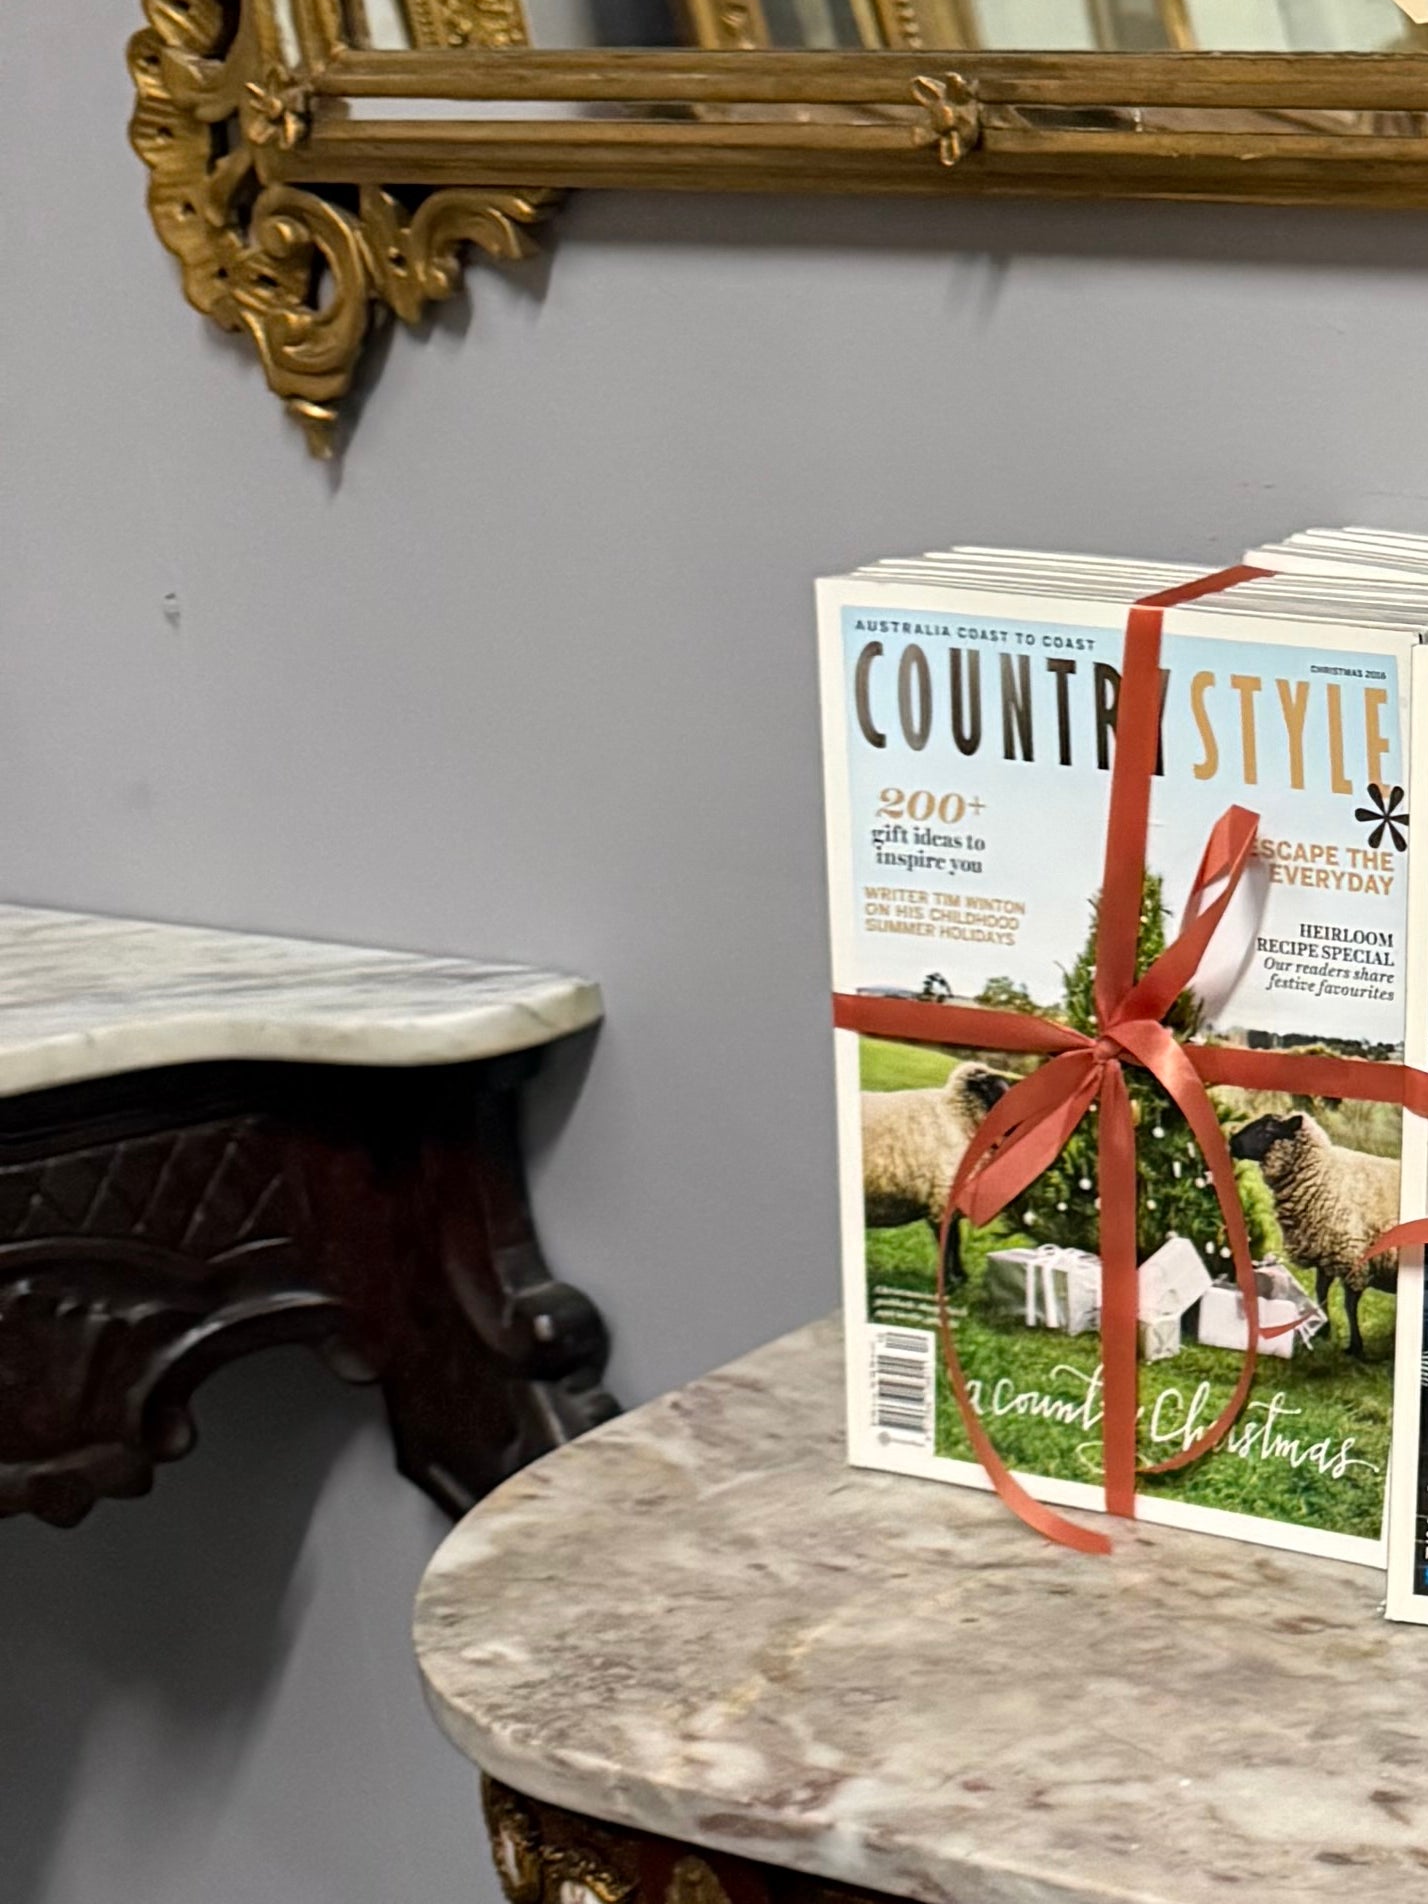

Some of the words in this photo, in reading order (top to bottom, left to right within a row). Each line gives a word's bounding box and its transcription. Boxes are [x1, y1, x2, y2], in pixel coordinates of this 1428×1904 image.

[855, 620, 950, 637] AUSTRALIA
[958, 626, 1008, 642] COAST
[1042, 635, 1095, 651] COAST
[1190, 670, 1391, 799] STYLE
[876, 788, 986, 825] 200+
[871, 825, 908, 846] gift
[914, 827, 962, 848] ideas
[876, 848, 946, 872] inspire
[1269, 865, 1394, 896] EVERYDAY
[864, 887, 928, 904] WRITER
[934, 891, 960, 908] TIM
[964, 894, 1026, 914] WINTON
[896, 906, 924, 920] HIS
[931, 908, 1019, 930] CHILDHOOD
[865, 919, 934, 937] SUMMER
[939, 923, 1016, 946] HOLIDAYS
[1300, 924, 1394, 947] HEIRLOOM
[1257, 938, 1319, 958] RECIPE
[1322, 943, 1394, 966] SPECIAL
[1263, 957, 1293, 974] Our
[1296, 962, 1351, 981] readers
[1354, 967, 1394, 983] share
[1266, 974, 1316, 991] festive
[1315, 983, 1394, 1002] favourites
